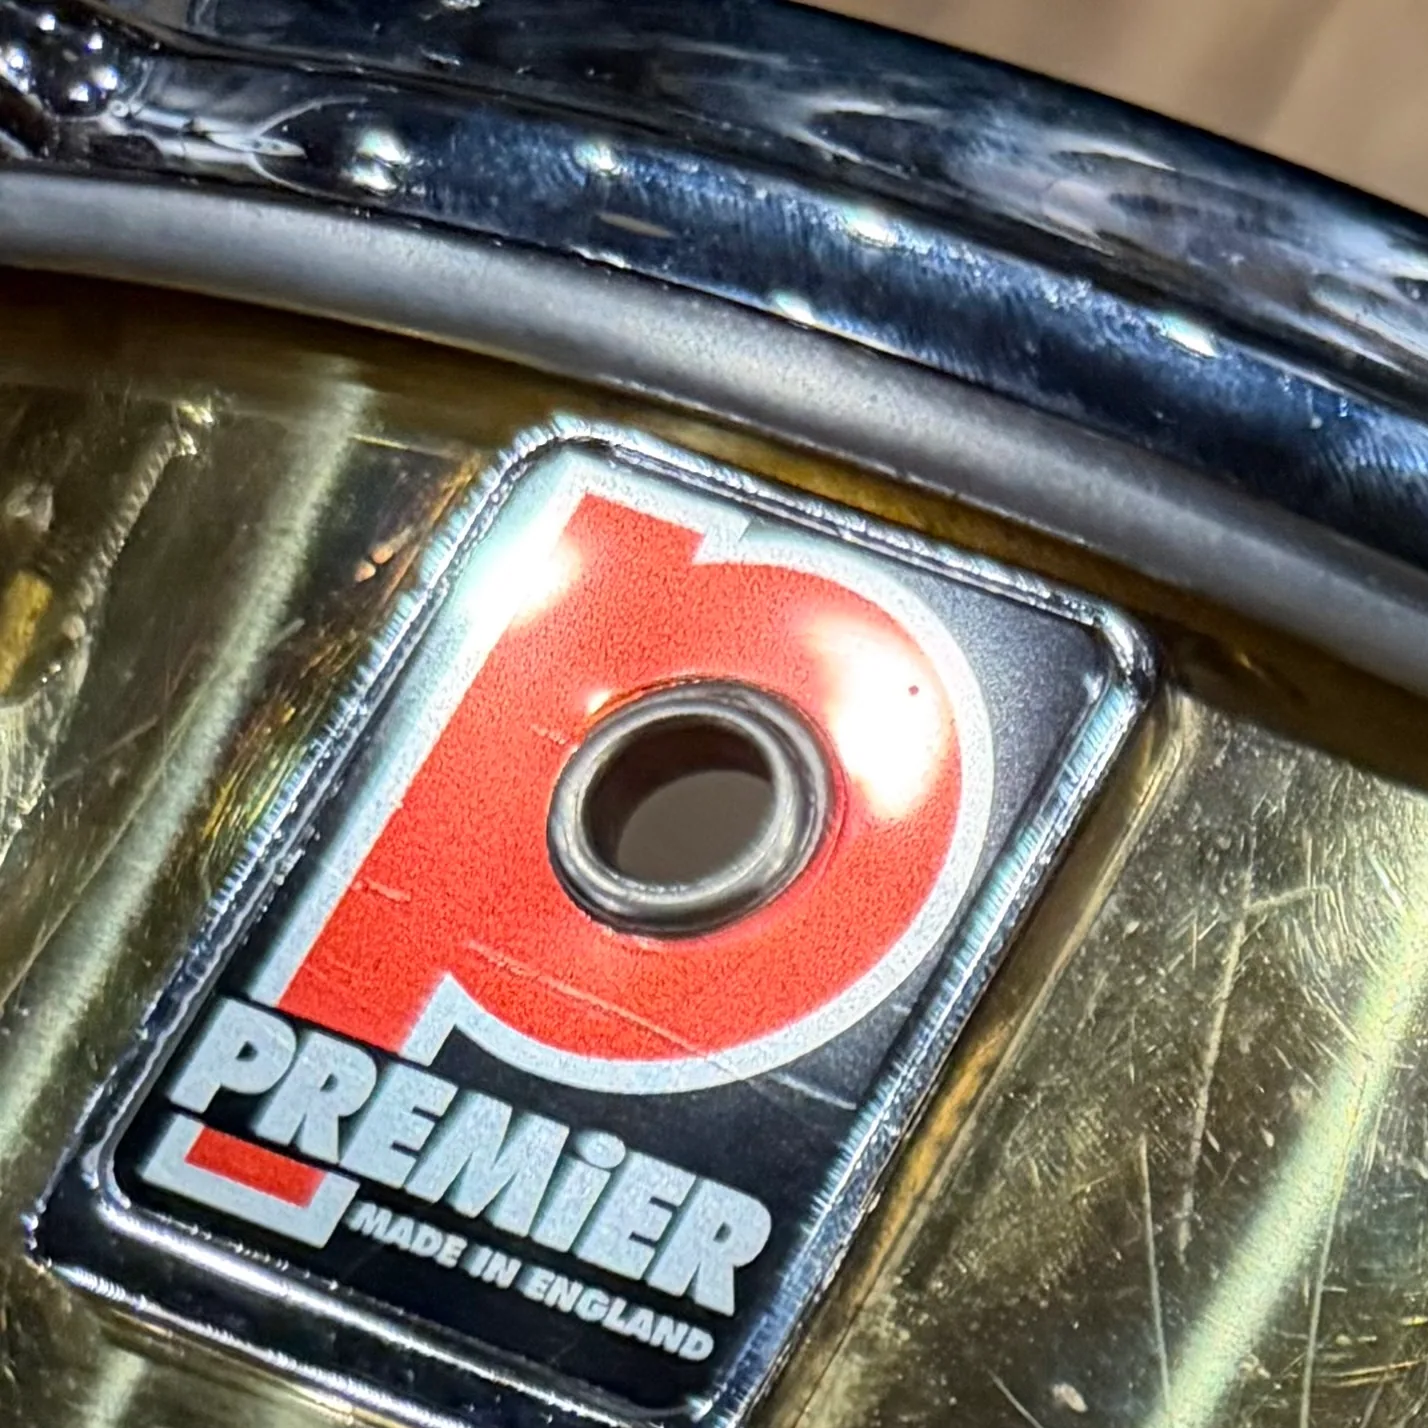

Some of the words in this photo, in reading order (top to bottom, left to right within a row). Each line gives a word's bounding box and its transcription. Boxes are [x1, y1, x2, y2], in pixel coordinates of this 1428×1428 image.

[348, 1202, 467, 1268] MADE
[466, 1243, 518, 1290] IN
[519, 1267, 715, 1362] ENGLAND
